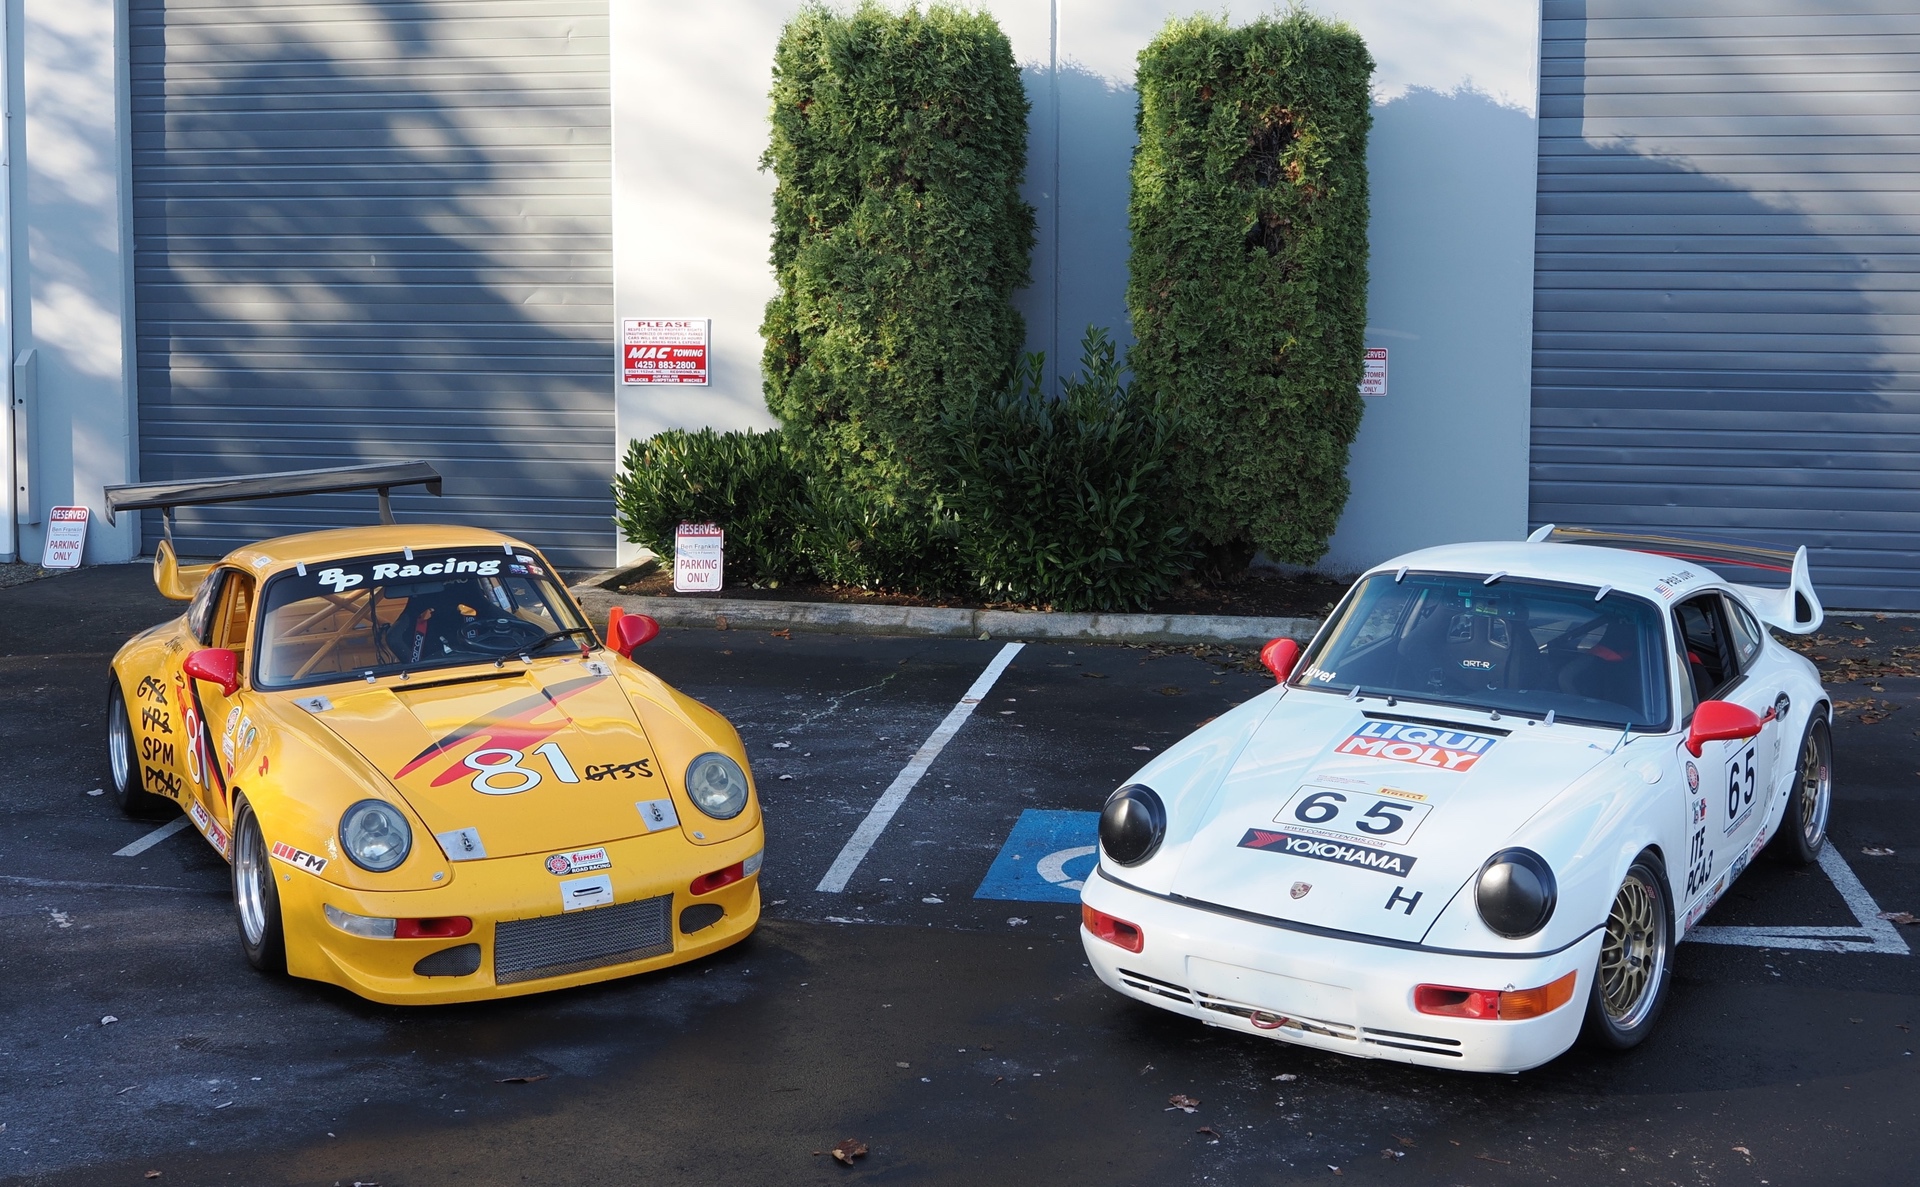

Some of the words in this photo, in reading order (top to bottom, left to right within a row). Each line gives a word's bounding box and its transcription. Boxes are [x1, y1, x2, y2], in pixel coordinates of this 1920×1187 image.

[627, 347, 672, 359] MAC
[673, 349, 704, 357] TOWING
[635, 361, 656, 369] (425)
[658, 361, 697, 369] 883-2800
[1364, 351, 1386, 359] ERVED
[52, 510, 87, 519] RESERVED
[679, 524, 720, 534] RESERVED
[50, 541, 79, 549] PARKING
[53, 552, 72, 560] ONLY
[318, 568, 364, 593] BP
[373, 557, 501, 580] Racing
[680, 560, 718, 569] PARKING
[687, 573, 710, 583] ONLY
[411, 634, 423, 664] parco
[1462, 659, 1490, 669] QRT-R
[142, 737, 174, 766] SPM
[186, 708, 210, 792] 81
[1358, 722, 1486, 753] LIQUI
[1340, 737, 1479, 769] MOLY
[463, 742, 581, 796] 81
[1728, 747, 1755, 820] 65
[1286, 837, 1402, 873] YOKOHAMA
[1690, 825, 1706, 868] ITE
[571, 866, 589, 874] ROAD
[589, 862, 611, 871] RACING
[1684, 849, 1714, 903] PCA3
[1384, 886, 1424, 916] H
